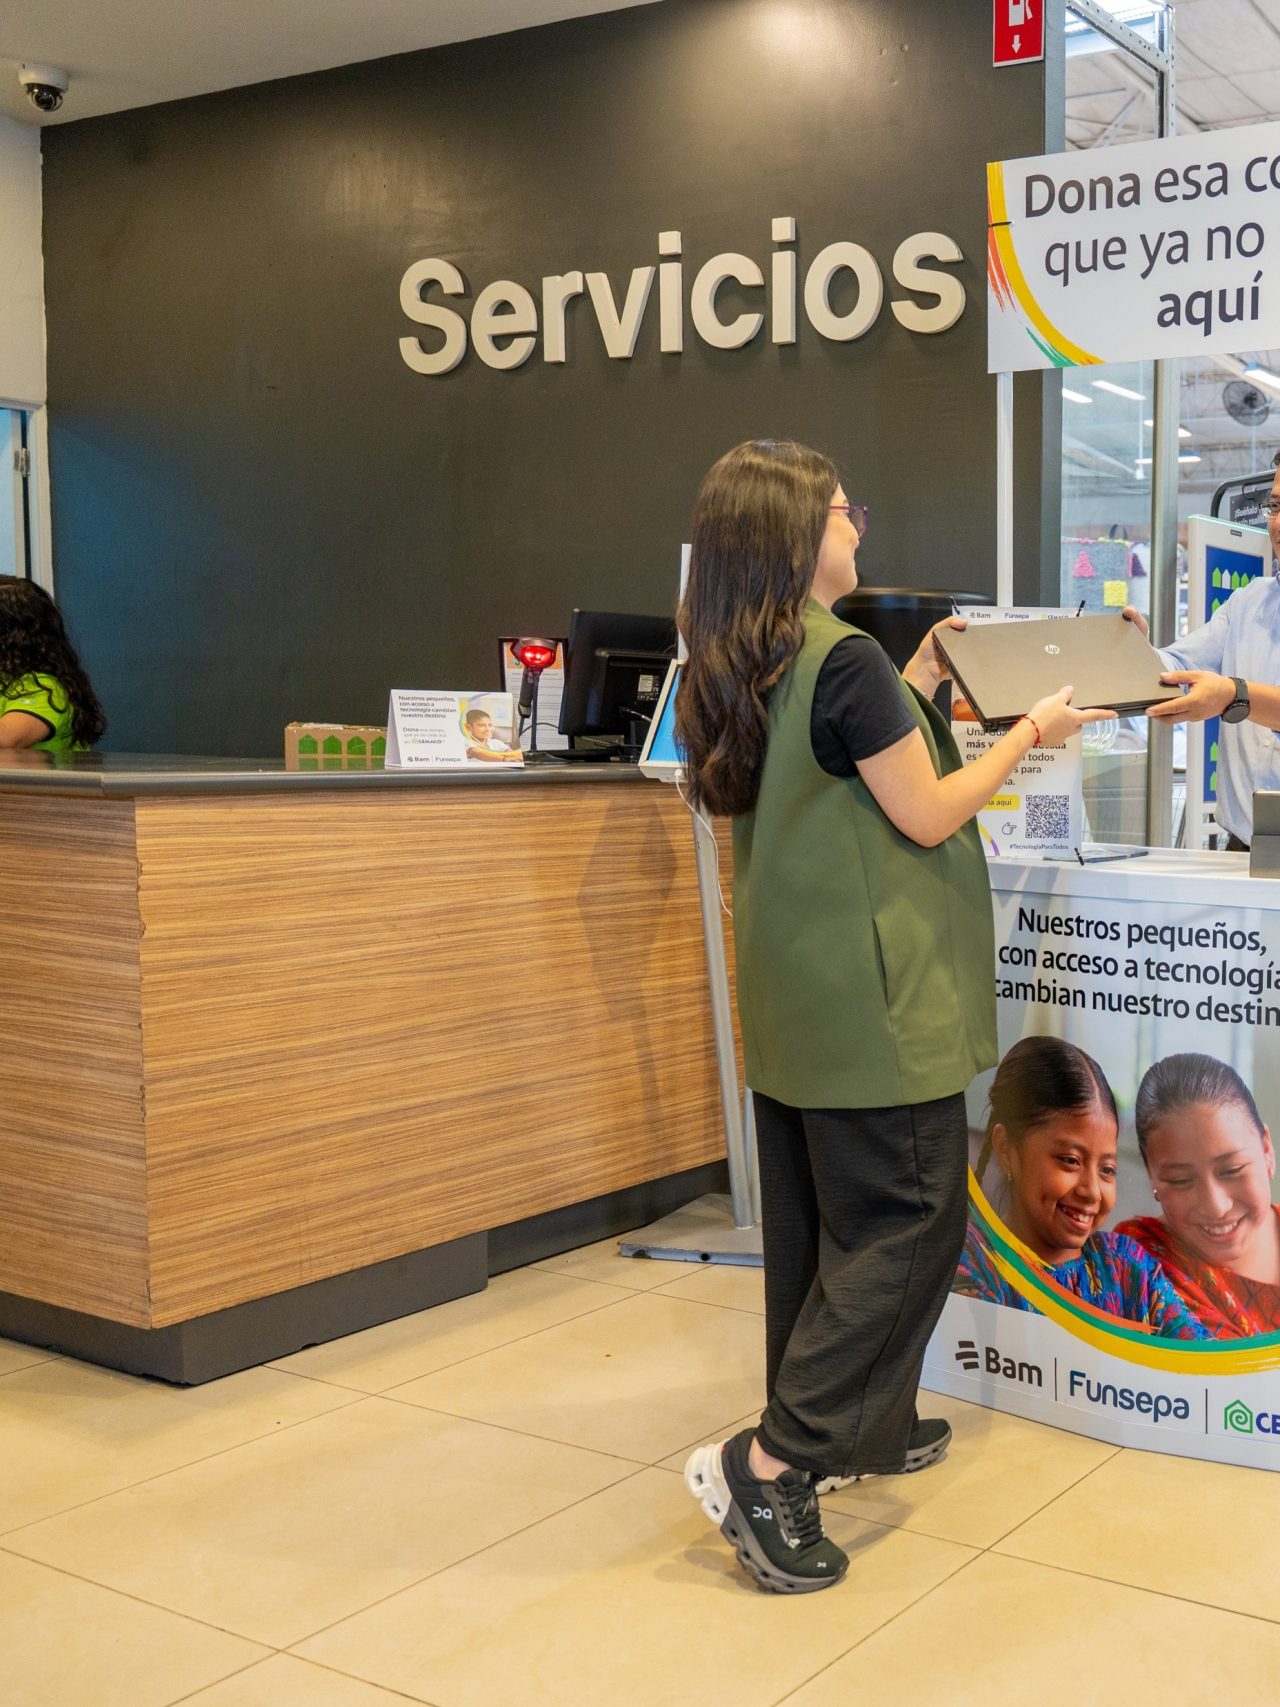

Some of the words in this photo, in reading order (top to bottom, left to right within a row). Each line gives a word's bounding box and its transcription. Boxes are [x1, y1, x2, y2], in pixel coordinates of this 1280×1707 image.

[1026, 172, 1140, 218] Dona
[1155, 161, 1228, 203] esa
[1046, 236, 1126, 288] que
[1140, 229, 1189, 280] ya
[1207, 221, 1265, 261] no
[399, 217, 966, 375] Servicios
[1157, 270, 1263, 337] aquí
[1004, 612, 1030, 620] Funsepa
[1047, 644, 1059, 655] hp
[966, 727, 985, 737] Una
[966, 738, 986, 749] más
[966, 753, 977, 761] es
[1028, 752, 1055, 762] todos
[1021, 766, 1042, 775] para
[996, 798, 1012, 808] aquí
[1018, 907, 1120, 941] Nuestros
[1127, 922, 1267, 956] pequeños,
[999, 945, 1037, 967] con
[1042, 950, 1118, 976] acceso
[1124, 959, 1138, 978] a
[1092, 991, 1190, 1020] nuestro
[985, 1347, 1042, 1387] Bam
[1069, 1370, 1190, 1423] Funsepa
